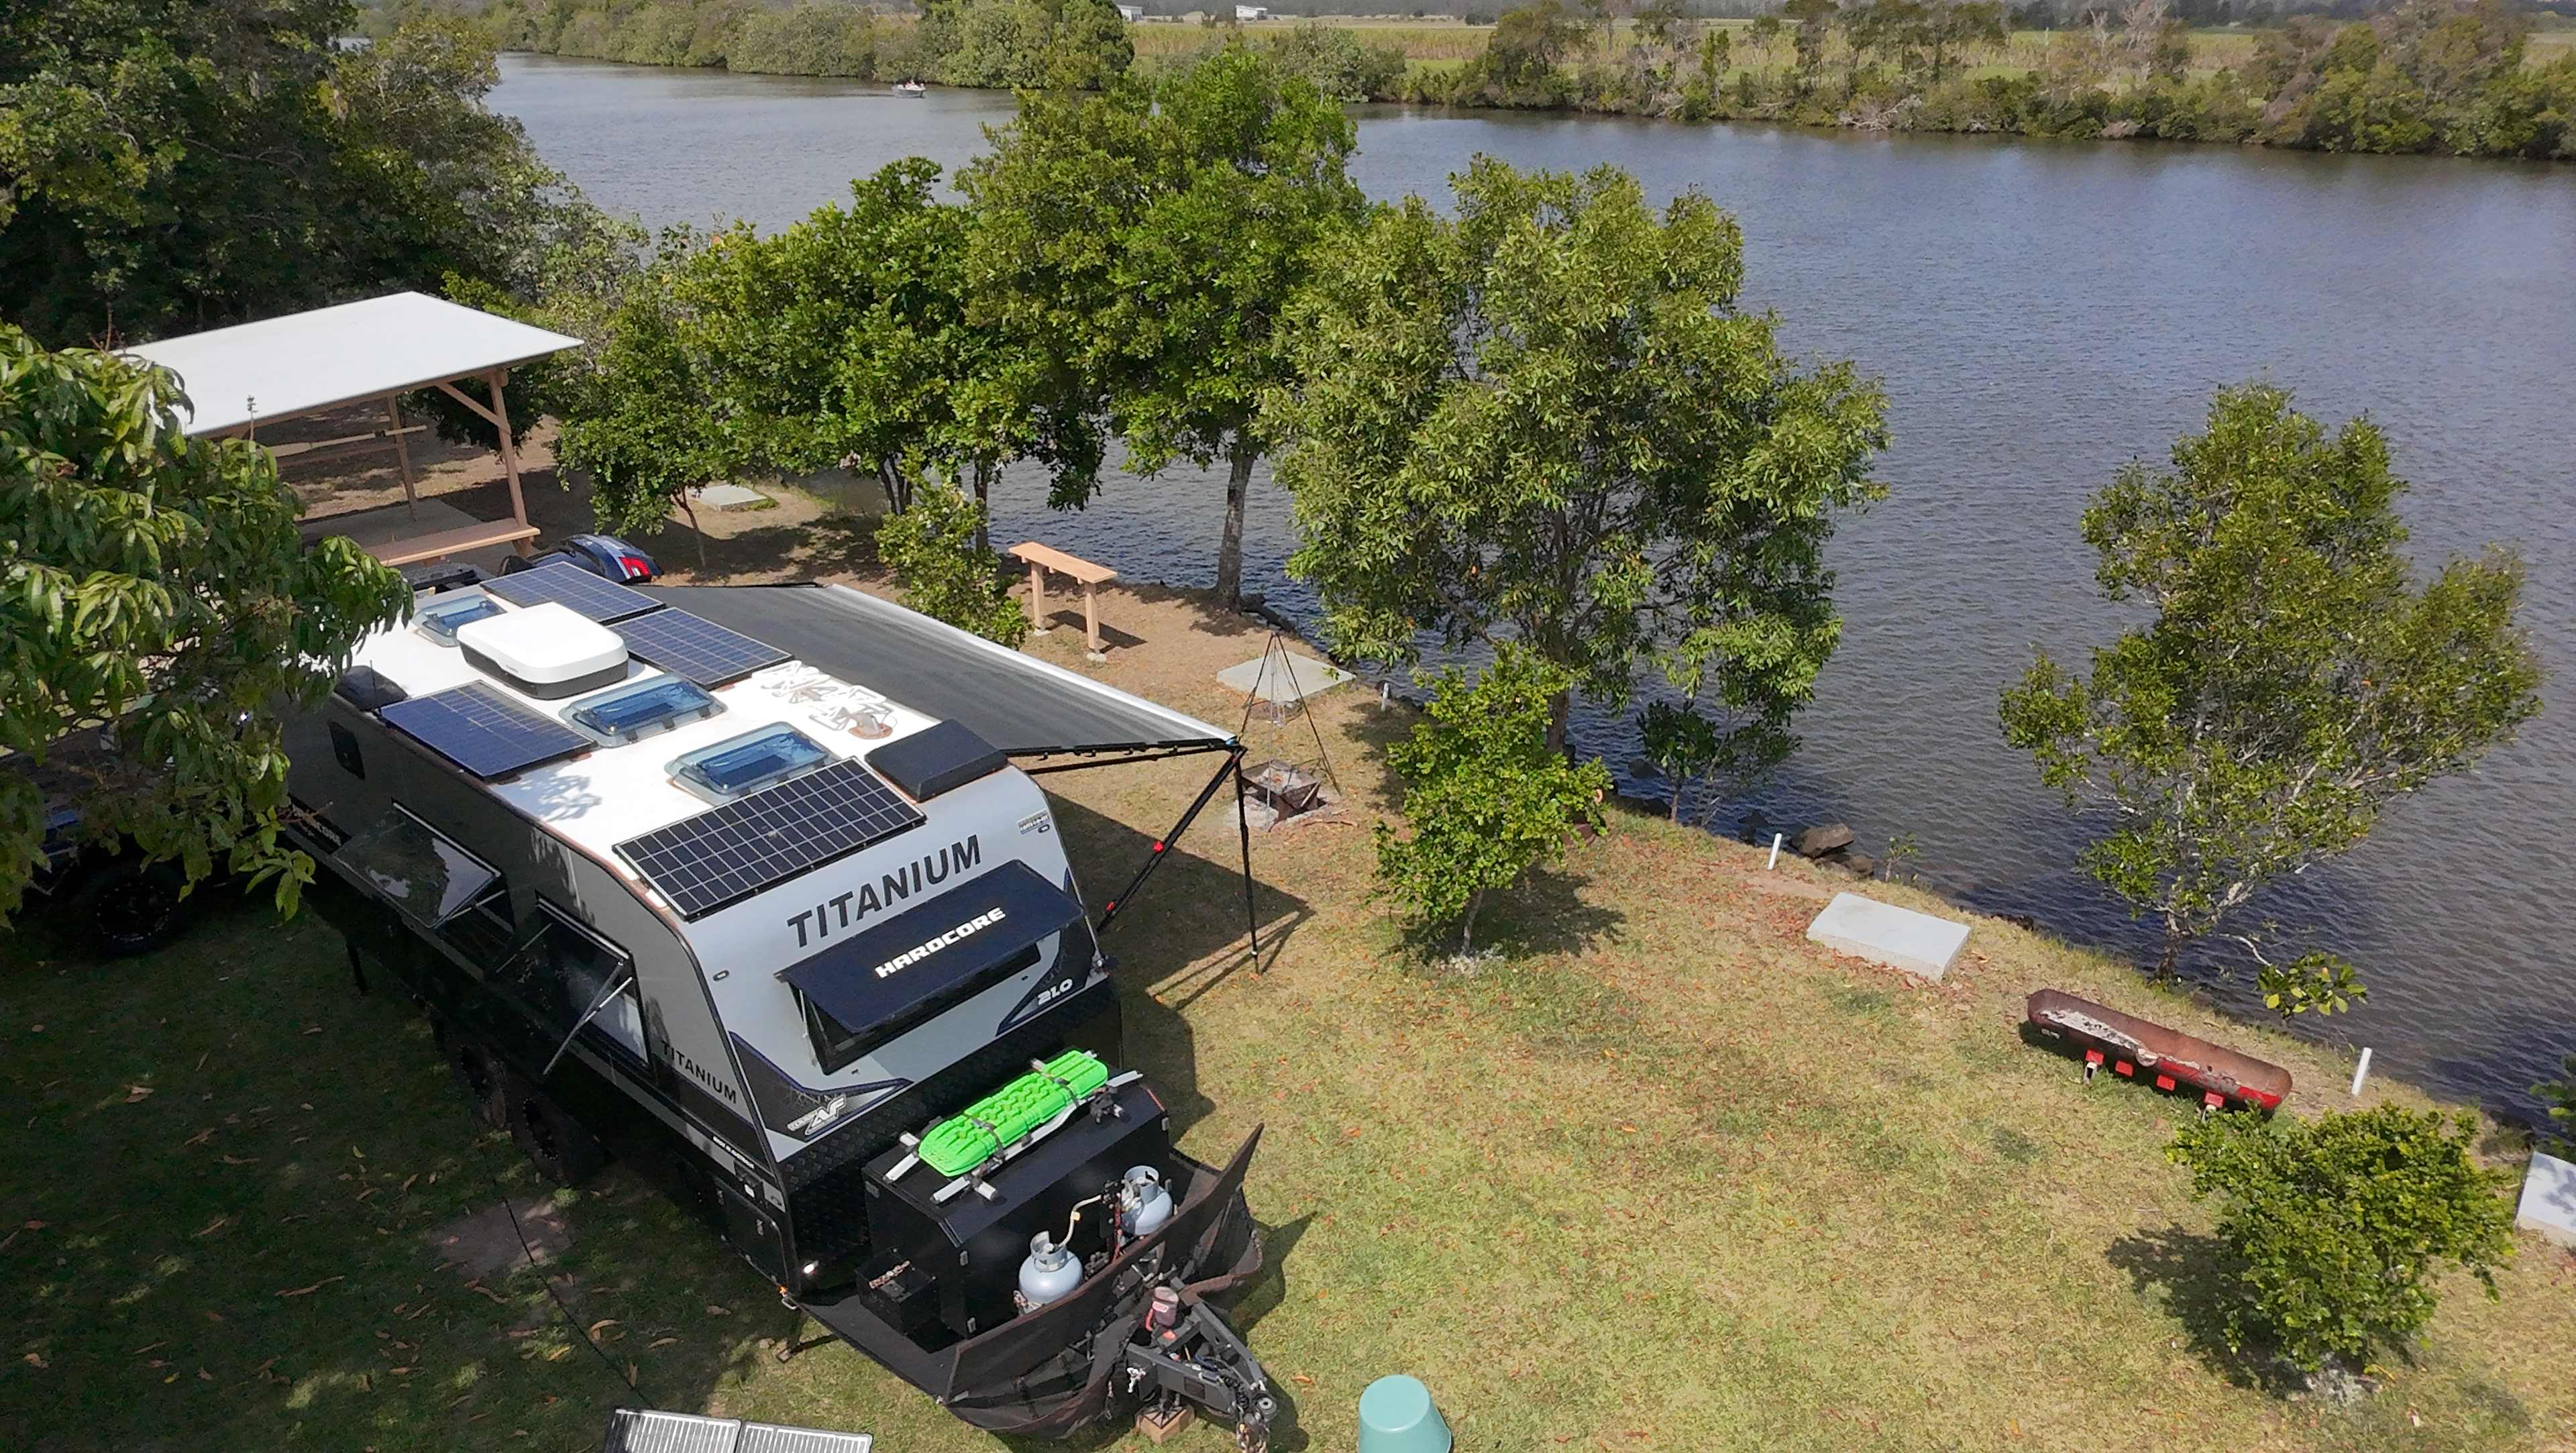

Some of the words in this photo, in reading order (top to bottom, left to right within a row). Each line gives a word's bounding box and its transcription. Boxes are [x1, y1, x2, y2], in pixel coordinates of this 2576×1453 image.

[787, 834, 981, 948] TITANIUM
[875, 907, 1006, 979] HARDCORE
[661, 1040, 737, 1104] TITANIUM
